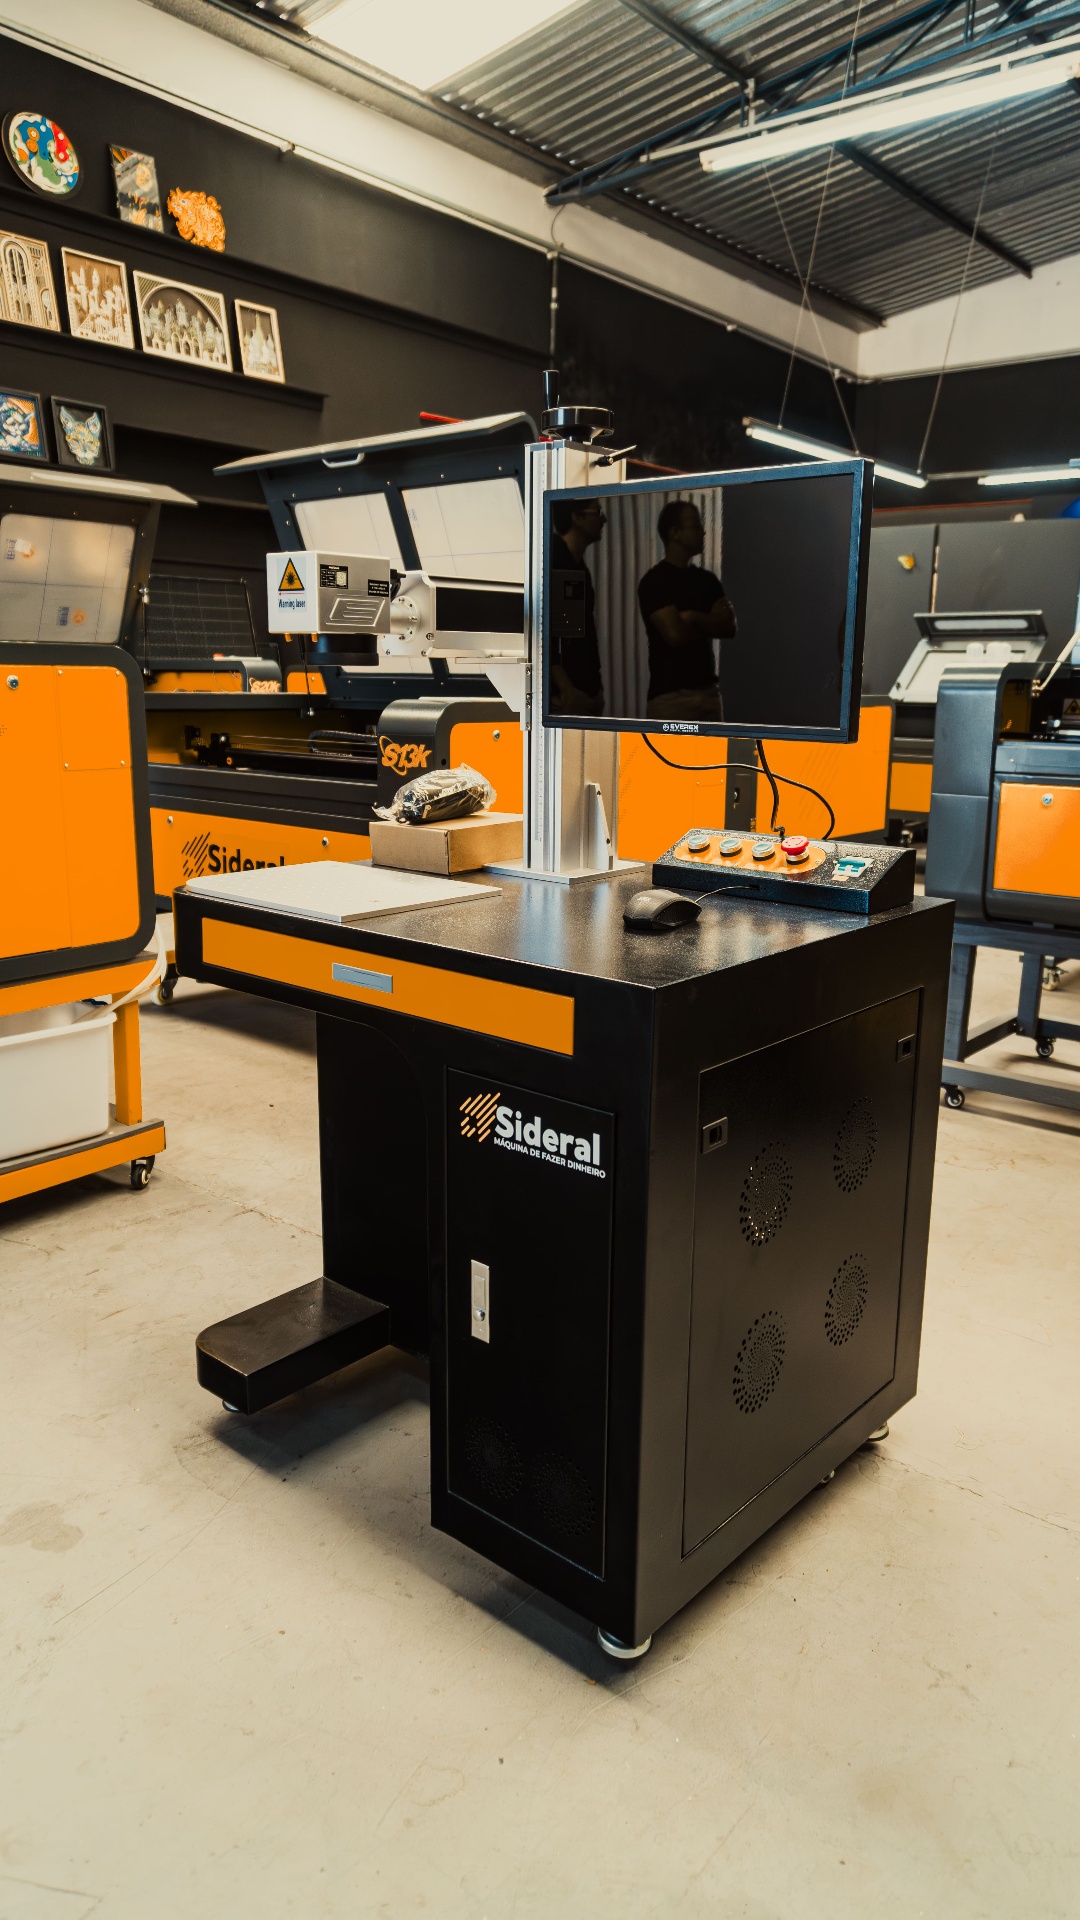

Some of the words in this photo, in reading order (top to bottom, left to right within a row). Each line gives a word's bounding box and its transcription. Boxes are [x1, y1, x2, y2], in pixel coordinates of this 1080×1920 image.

[278, 599, 295, 610] Warning
[296, 599, 306, 608] laser
[495, 1106, 600, 1165] Sideral
[494, 1137, 528, 1154] MÁQUINA
[529, 1149, 541, 1158] DE
[541, 1152, 566, 1166] FAZER
[567, 1160, 606, 1179] DINHEIRO
